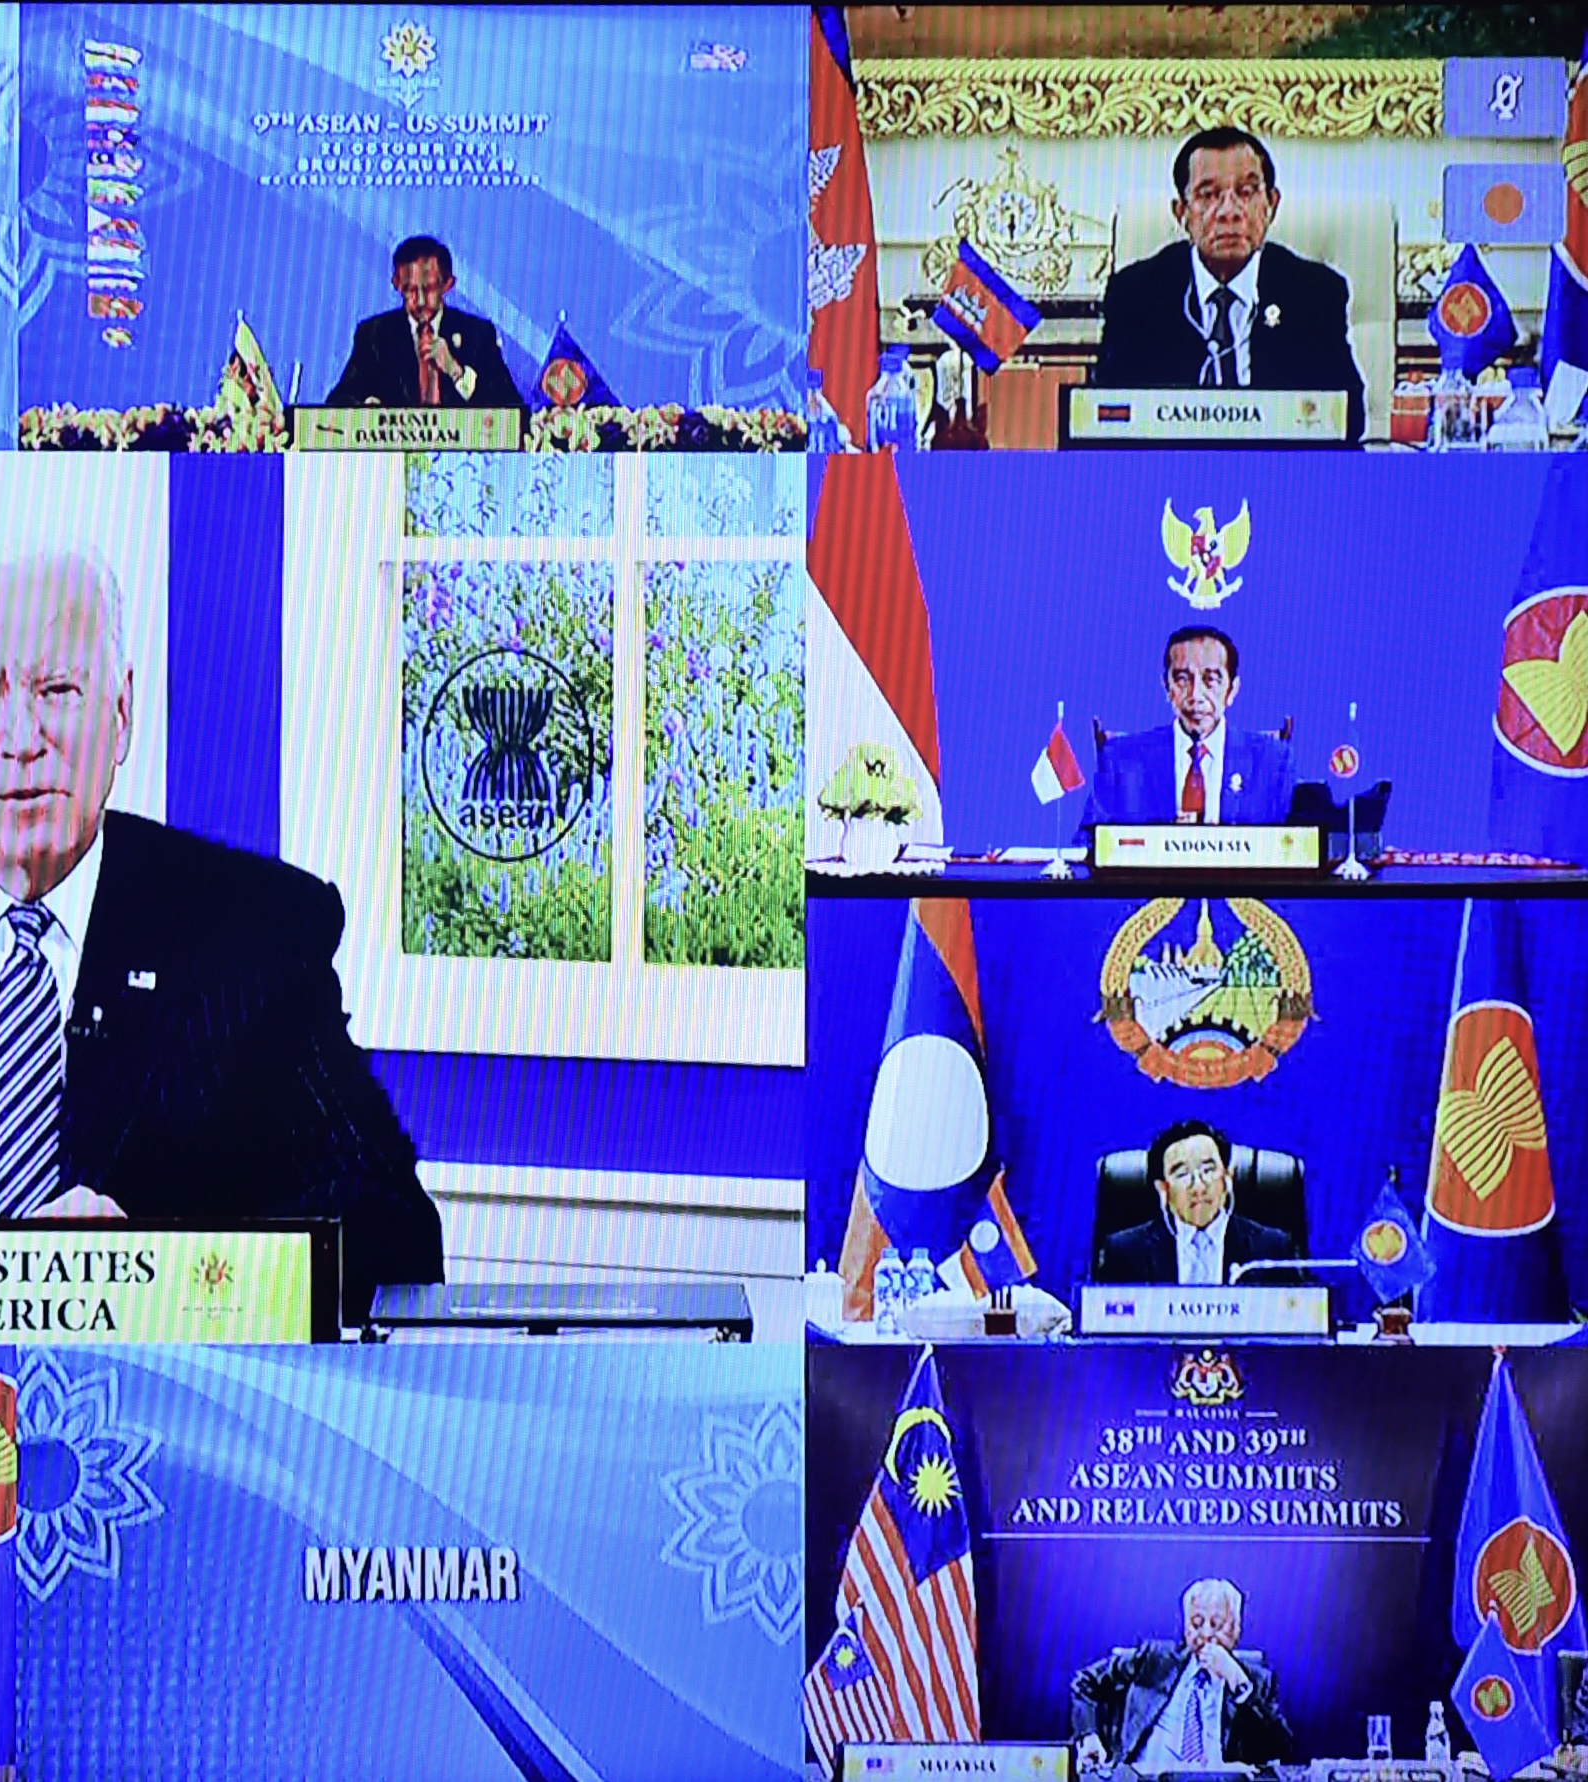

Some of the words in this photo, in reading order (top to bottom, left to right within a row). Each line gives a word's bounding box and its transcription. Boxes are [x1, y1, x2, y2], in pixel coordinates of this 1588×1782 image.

[406, 113, 439, 133] US
[443, 113, 550, 133] SUMMIT
[1156, 405, 1262, 423] CAMBODIA
[1164, 839, 1251, 853] INDONESIA
[1100, 1426, 1162, 1455] 38TH
[1169, 1429, 1236, 1455] AND
[1244, 1427, 1307, 1455] 39TH
[1069, 1463, 1176, 1490] ASEAN
[1184, 1464, 1338, 1491] SUMMITS
[1012, 1498, 1080, 1524] AND
[1090, 1498, 1241, 1526] RELATED
[1249, 1498, 1403, 1526] SUMMITS
[304, 1546, 519, 1602] MYANMAR
